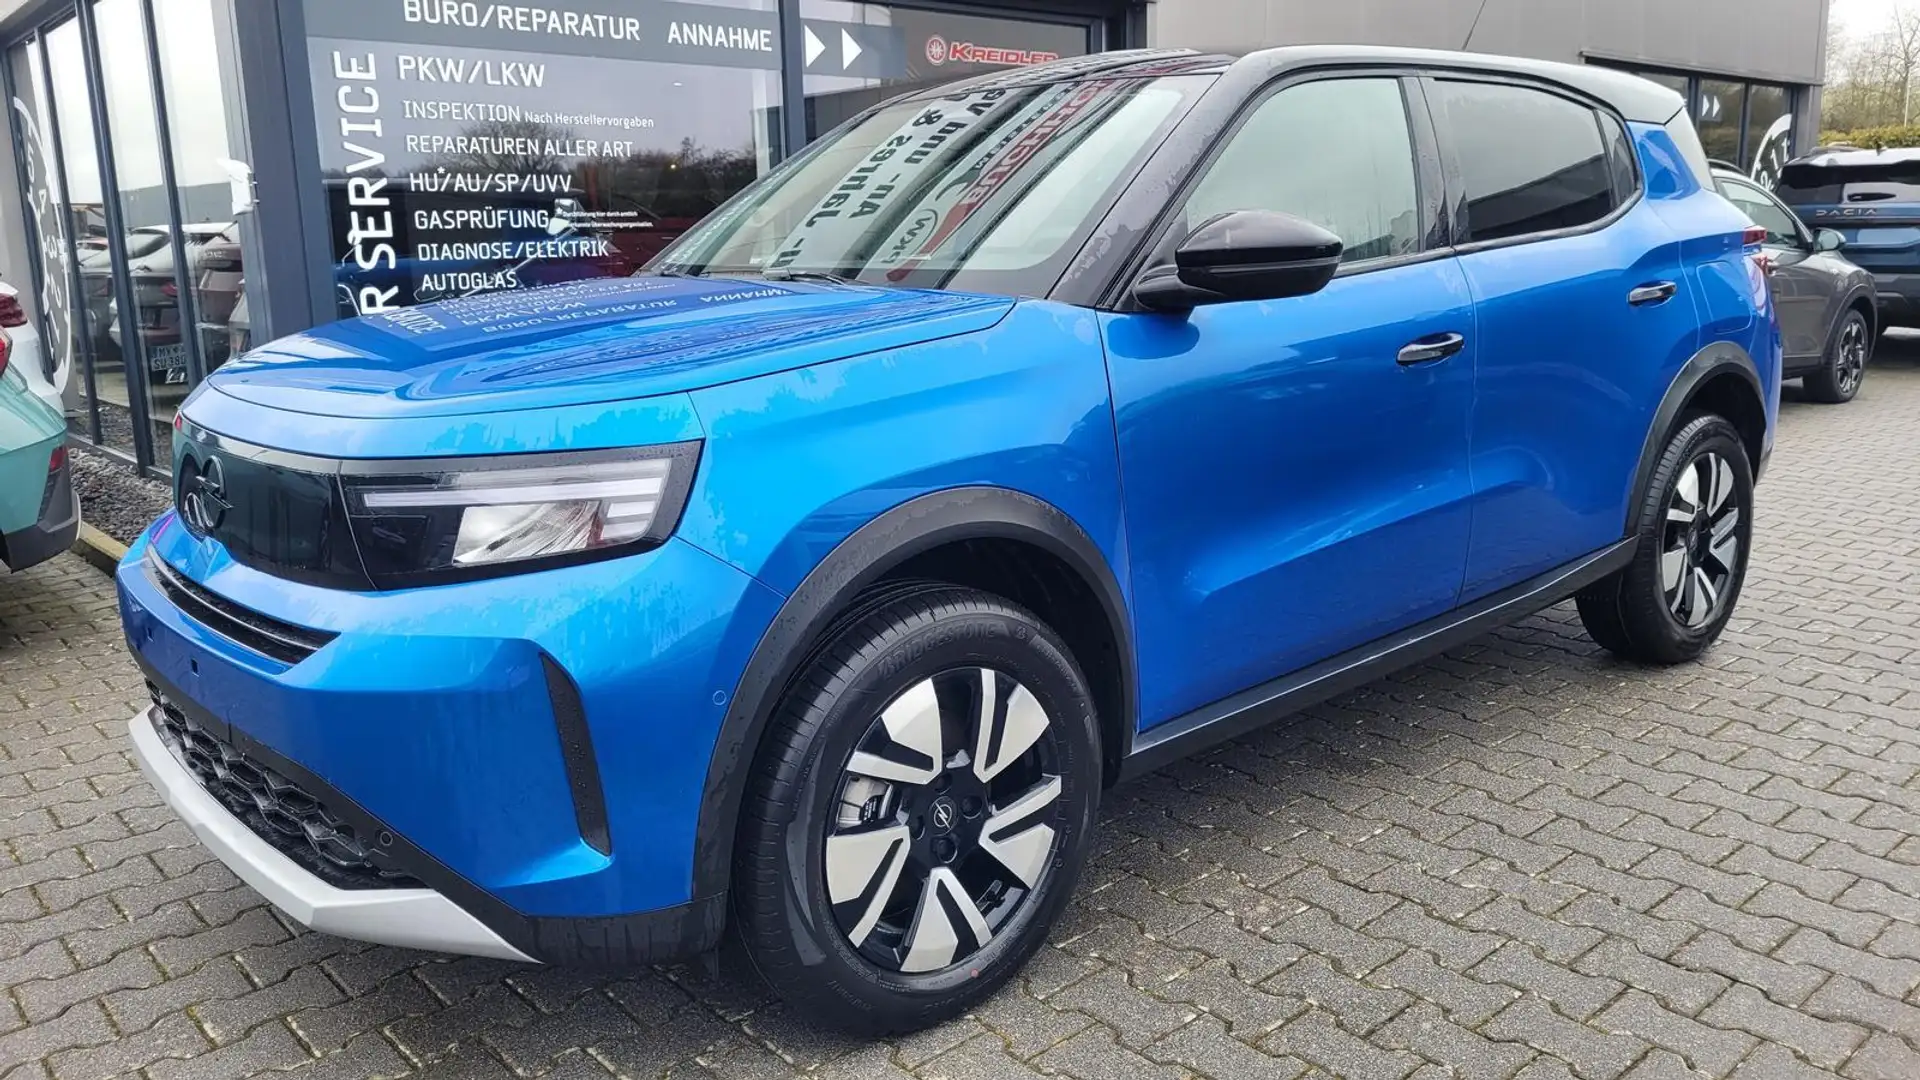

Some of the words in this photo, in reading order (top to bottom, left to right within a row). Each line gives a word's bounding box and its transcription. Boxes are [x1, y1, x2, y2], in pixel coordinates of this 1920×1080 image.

[667, 21, 773, 52] ANNAHME
[397, 55, 545, 88] PKW/LKW
[402, 100, 521, 122] INSPEKTION
[524, 111, 553, 125] Nach
[555, 112, 654, 130] Herstellervorgaben
[405, 135, 540, 156] REPARATUREN
[543, 138, 598, 157] ALLER
[602, 140, 634, 158] ART
[333, 50, 396, 270] SERVICE
[414, 206, 549, 230] GASPRÜFUNG
[1815, 208, 1877, 216] DACIA
[417, 240, 610, 262] DIAGNOSE/ELEKTRIK
[421, 271, 518, 292] AUTOGLAS
